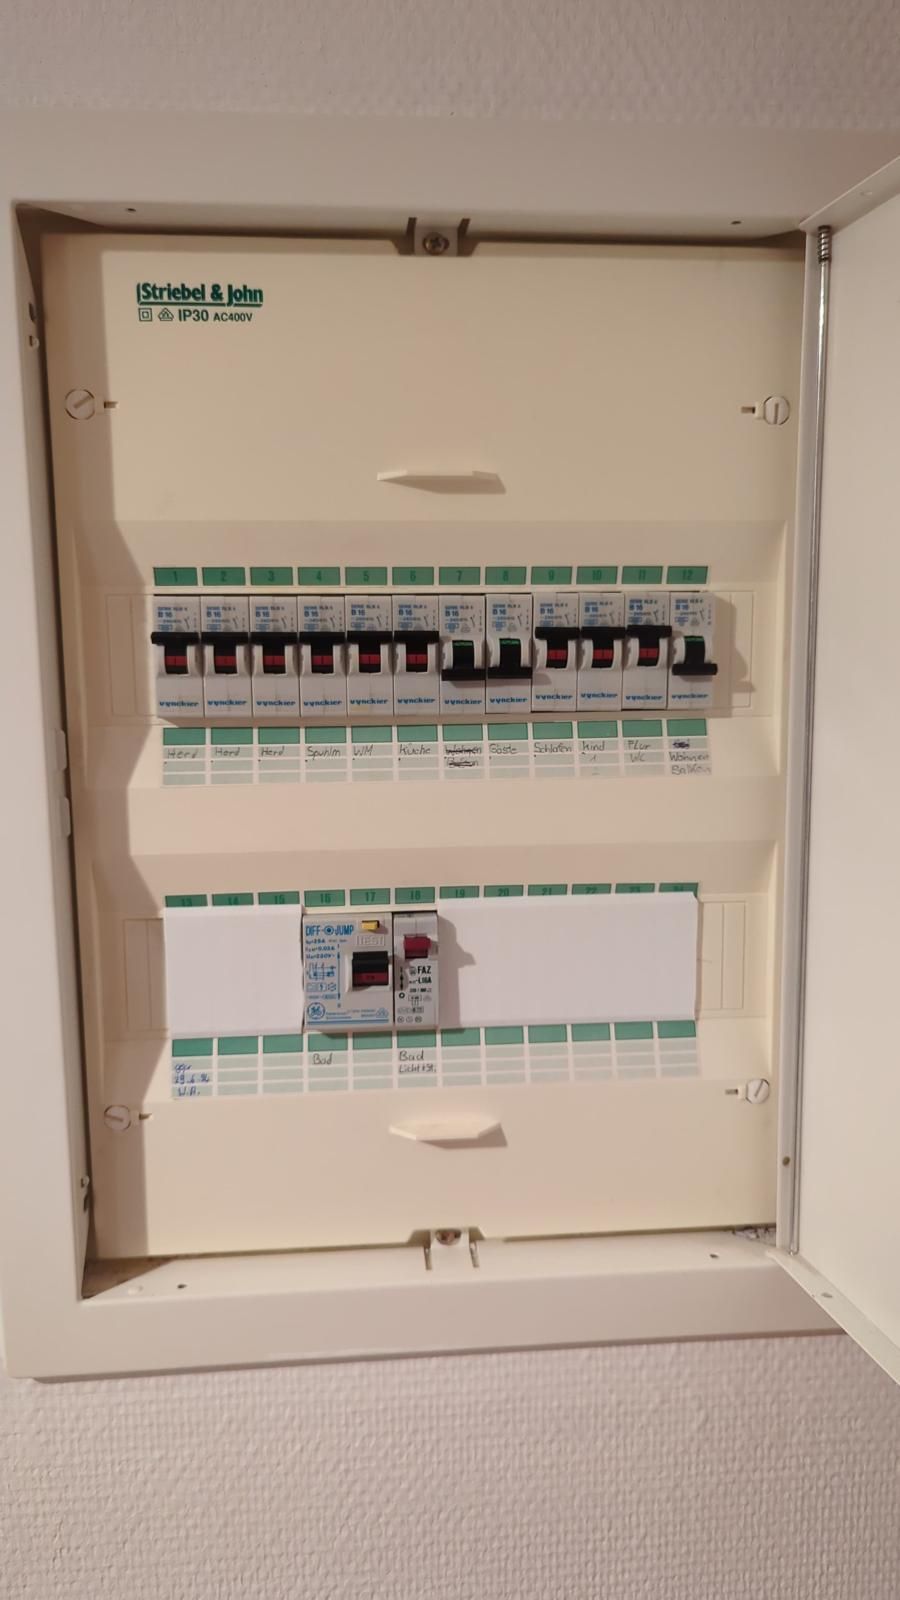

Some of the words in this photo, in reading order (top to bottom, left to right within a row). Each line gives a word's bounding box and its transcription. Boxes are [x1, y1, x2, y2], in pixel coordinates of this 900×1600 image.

[141, 283, 206, 301] Striebel
[210, 283, 224, 301] &
[226, 284, 264, 306] John
[178, 309, 209, 322] IP30
[213, 312, 253, 322] AC400V
[172, 570, 178, 582] 1
[220, 571, 227, 582] 2
[268, 570, 275, 582] 3
[316, 570, 322, 582] 4
[363, 570, 369, 582] 5
[410, 570, 416, 581] 6
[456, 570, 462, 582] 7
[503, 570, 509, 581] 8
[548, 569, 555, 581] 9
[592, 569, 602, 580] 10
[639, 569, 646, 580] 11
[682, 569, 693, 580] 12
[167, 748, 199, 759] Herd
[214, 746, 241, 757] Herd
[261, 745, 285, 757] Herd
[353, 744, 374, 756] WM
[365, 891, 376, 902] 17
[410, 890, 421, 900] 18
[455, 889, 465, 898] 19
[497, 888, 509, 896] 20
[542, 887, 552, 895] 21
[274, 894, 285, 904] 15
[320, 893, 331, 904] 16
[417, 966, 432, 975] FAZ
[313, 1053, 333, 1065] Bad
[399, 1050, 424, 1061] Bad
